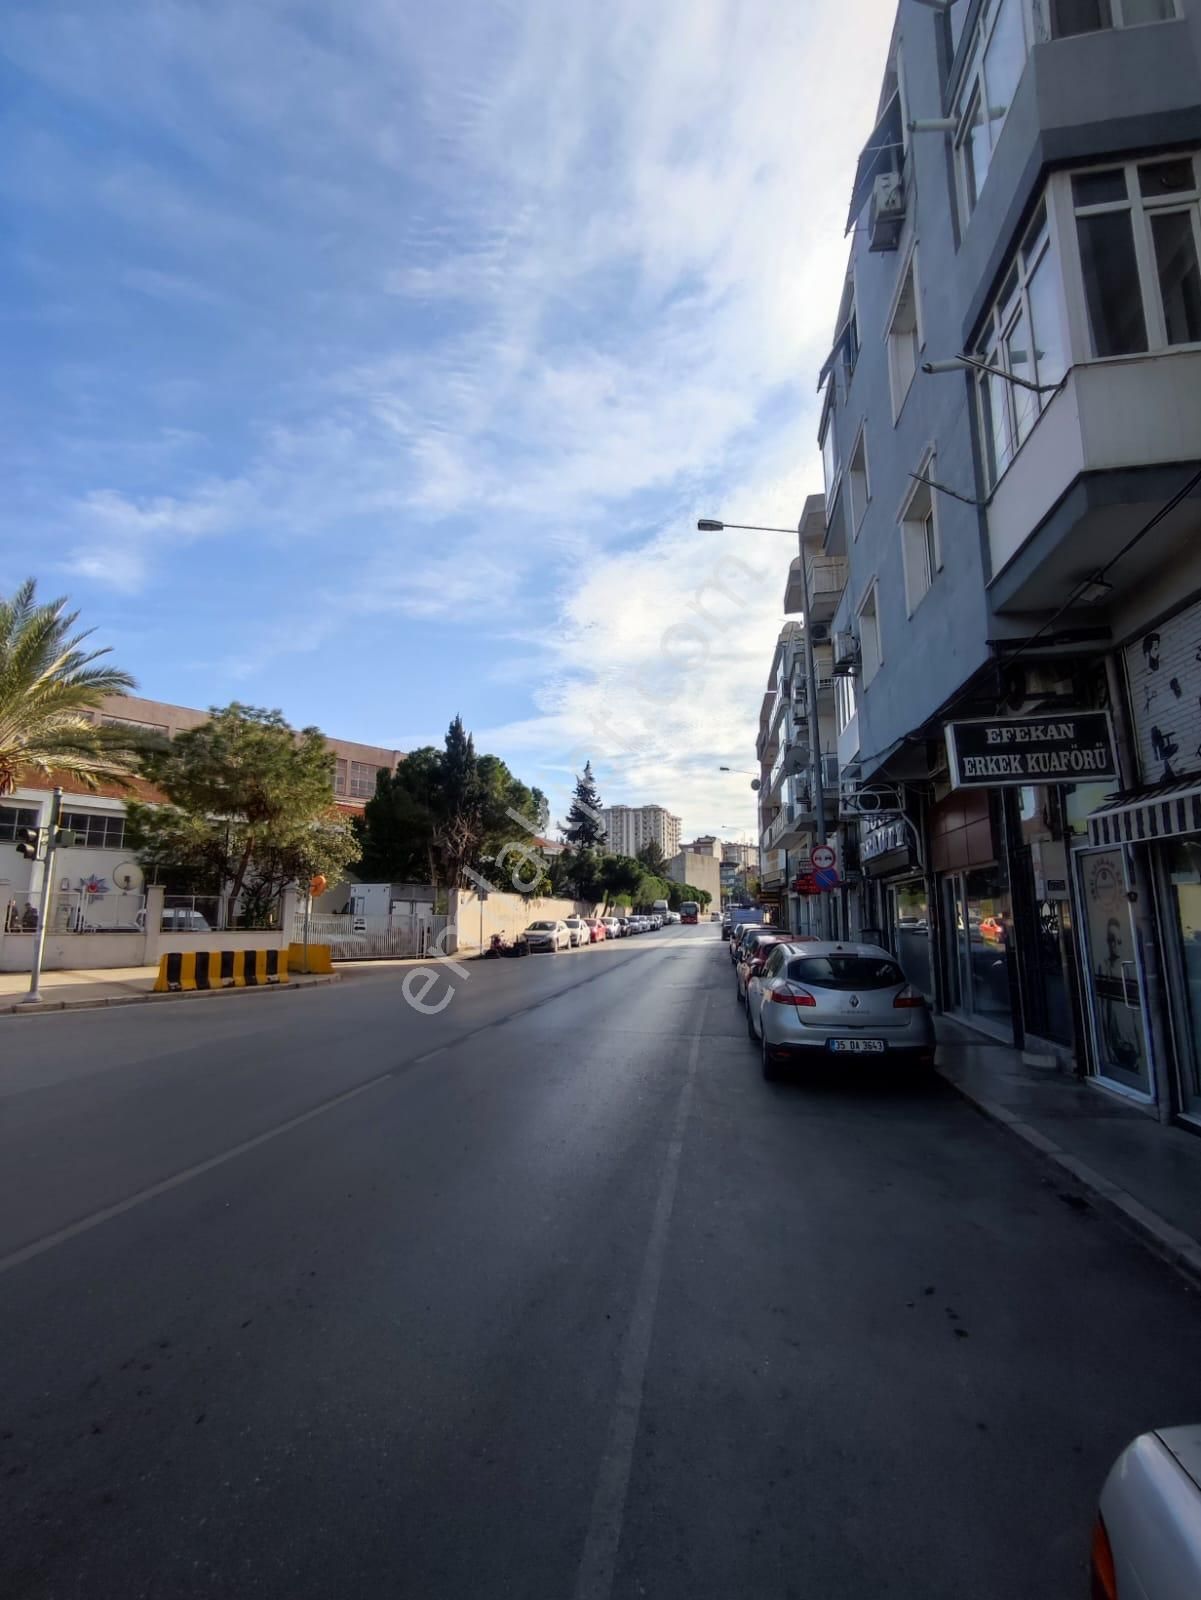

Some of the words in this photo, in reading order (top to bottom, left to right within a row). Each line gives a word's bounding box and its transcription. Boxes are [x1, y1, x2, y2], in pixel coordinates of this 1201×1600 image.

[985, 723, 1076, 744] EFEKAN
[963, 754, 1024, 777] ERKEK
[1027, 743, 1107, 774] KUAFÖRÜ
